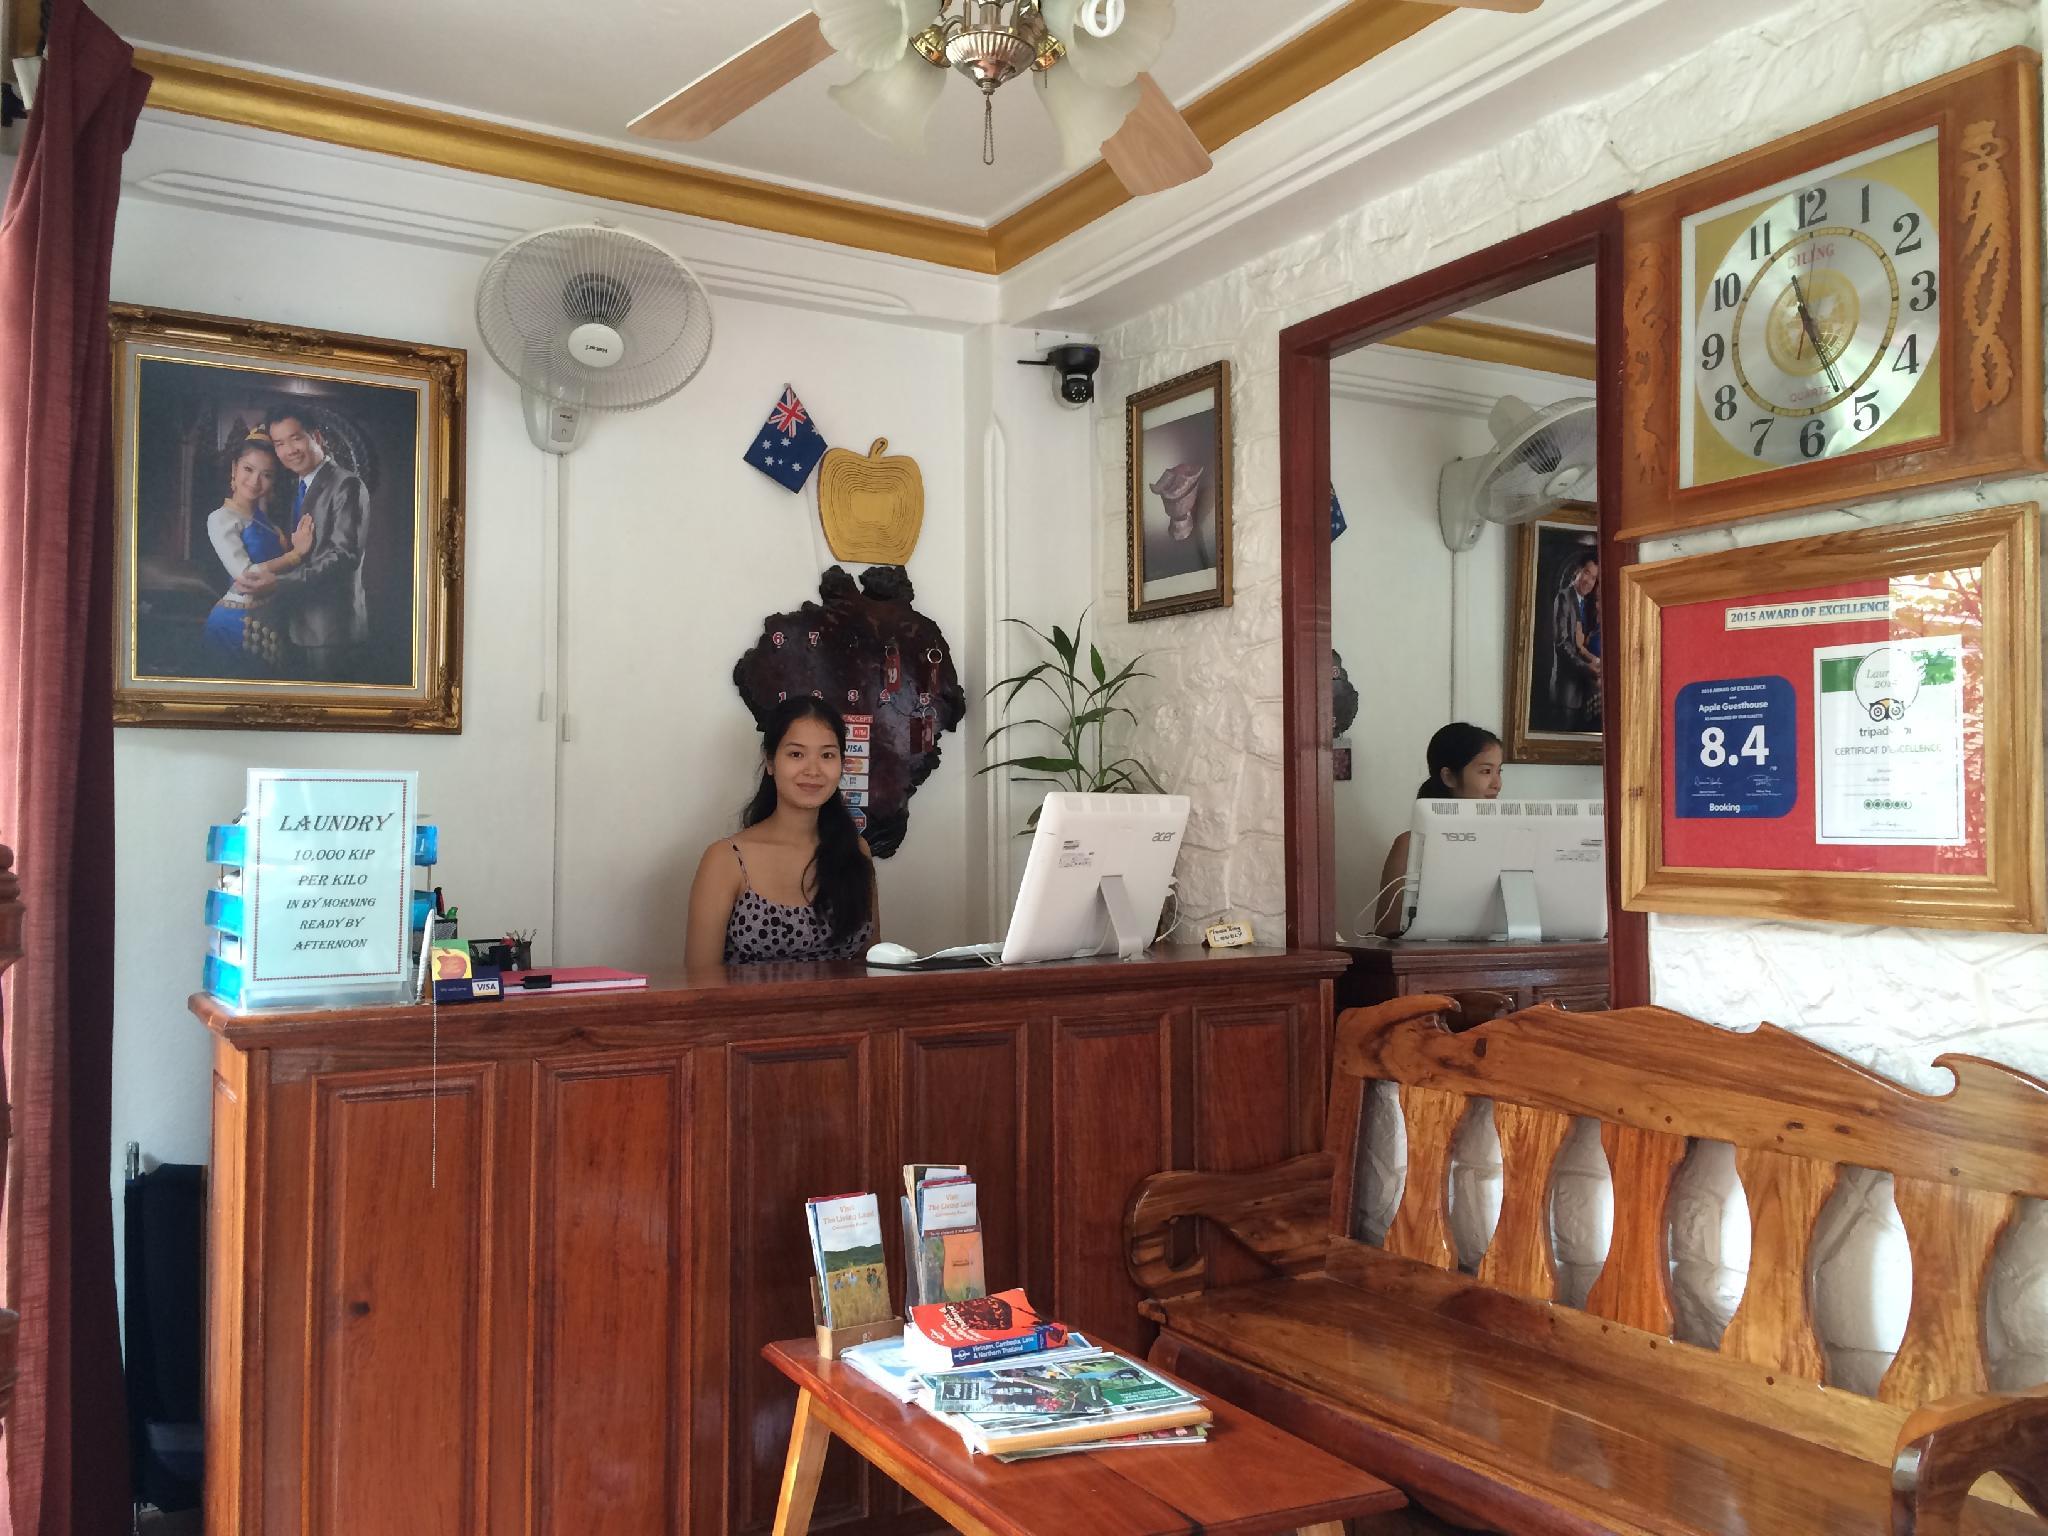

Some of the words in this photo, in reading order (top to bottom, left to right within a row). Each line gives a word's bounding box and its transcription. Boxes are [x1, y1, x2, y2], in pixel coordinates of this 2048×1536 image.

[1799, 188, 1828, 230] 12
[1861, 184, 1870, 223] 1
[1750, 220, 1771, 260] 11
[1893, 212, 1921, 256] 2
[1714, 272, 1741, 312] 10
[1910, 270, 1936, 311] 3
[1702, 334, 1725, 370] 9
[1892, 333, 1919, 374] 4
[1715, 385, 1737, 421] 8
[1854, 390, 1880, 431] 5
[1750, 418, 1775, 456] 7
[1800, 419, 1826, 458] 6
[1731, 611, 1756, 623] 2015
[1758, 608, 1799, 622] AWARD
[1801, 606, 1816, 618] OF
[1818, 600, 1890, 617] EXCELLENCE
[772, 631, 785, 646] 6
[808, 631, 820, 645] 7
[1698, 703, 1721, 714] Apple
[1722, 701, 1769, 711] Guesthouse
[1699, 725, 1770, 768] 8.4
[1834, 746, 1878, 756] CERTIFICAT
[278, 812, 395, 832] LAUNDRY
[1151, 831, 1176, 842] acer
[294, 849, 346, 861] 10,000
[348, 849, 376, 860] KIP
[298, 874, 329, 886] PER
[331, 874, 368, 886] KILO
[286, 899, 300, 909] IN
[301, 897, 323, 909] BY
[322, 897, 377, 908] MORNING
[299, 917, 346, 930] READY
[345, 916, 366, 928] BY
[293, 938, 368, 950] AFTERNOON
[476, 983, 496, 991] VISA
[978, 1349, 1001, 1358] Northern
[1002, 1344, 1023, 1354] Thailand
